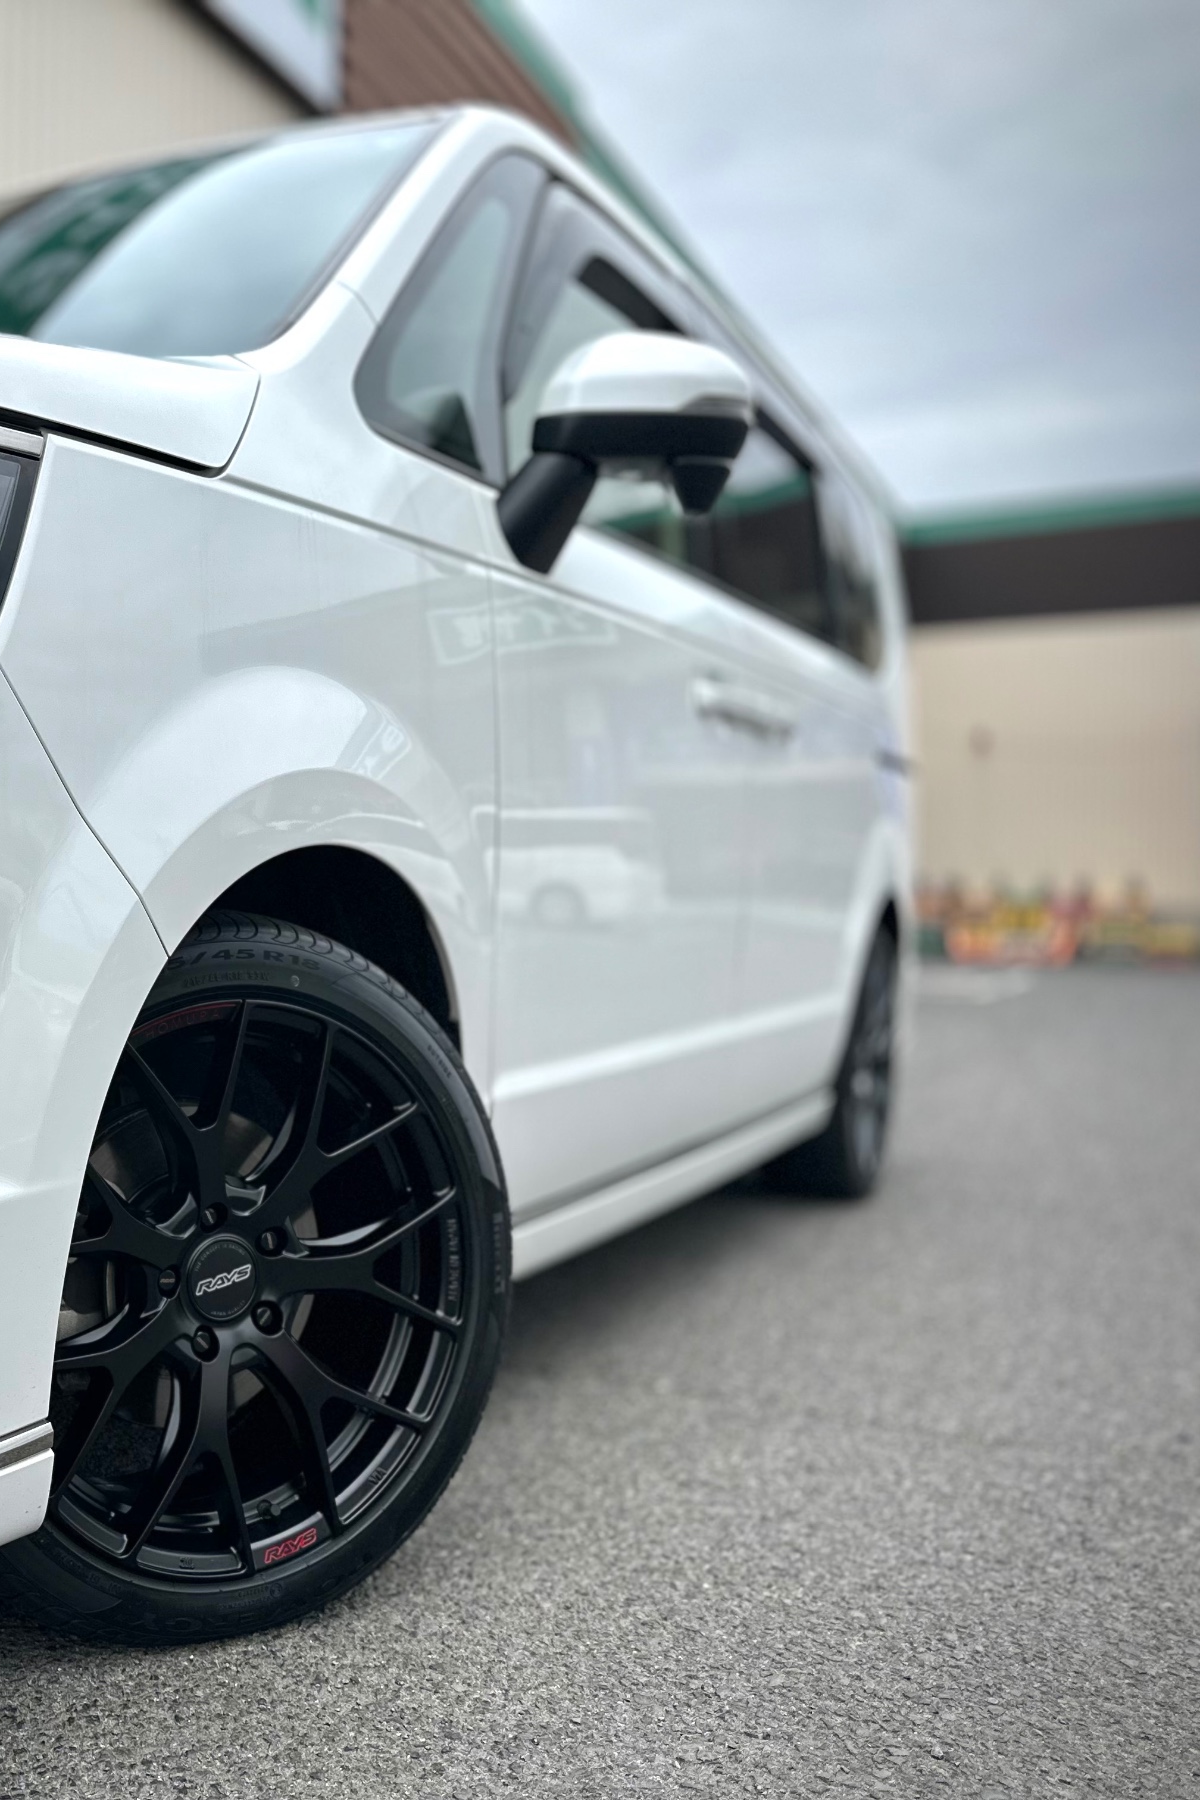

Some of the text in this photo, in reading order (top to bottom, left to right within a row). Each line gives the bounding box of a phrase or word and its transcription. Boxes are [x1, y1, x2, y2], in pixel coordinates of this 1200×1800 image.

[263, 949, 321, 971] R18
[144, 1010, 221, 1039] HOMURA
[195, 1263, 252, 1297] RAYS
[264, 1527, 318, 1564] RAYS
